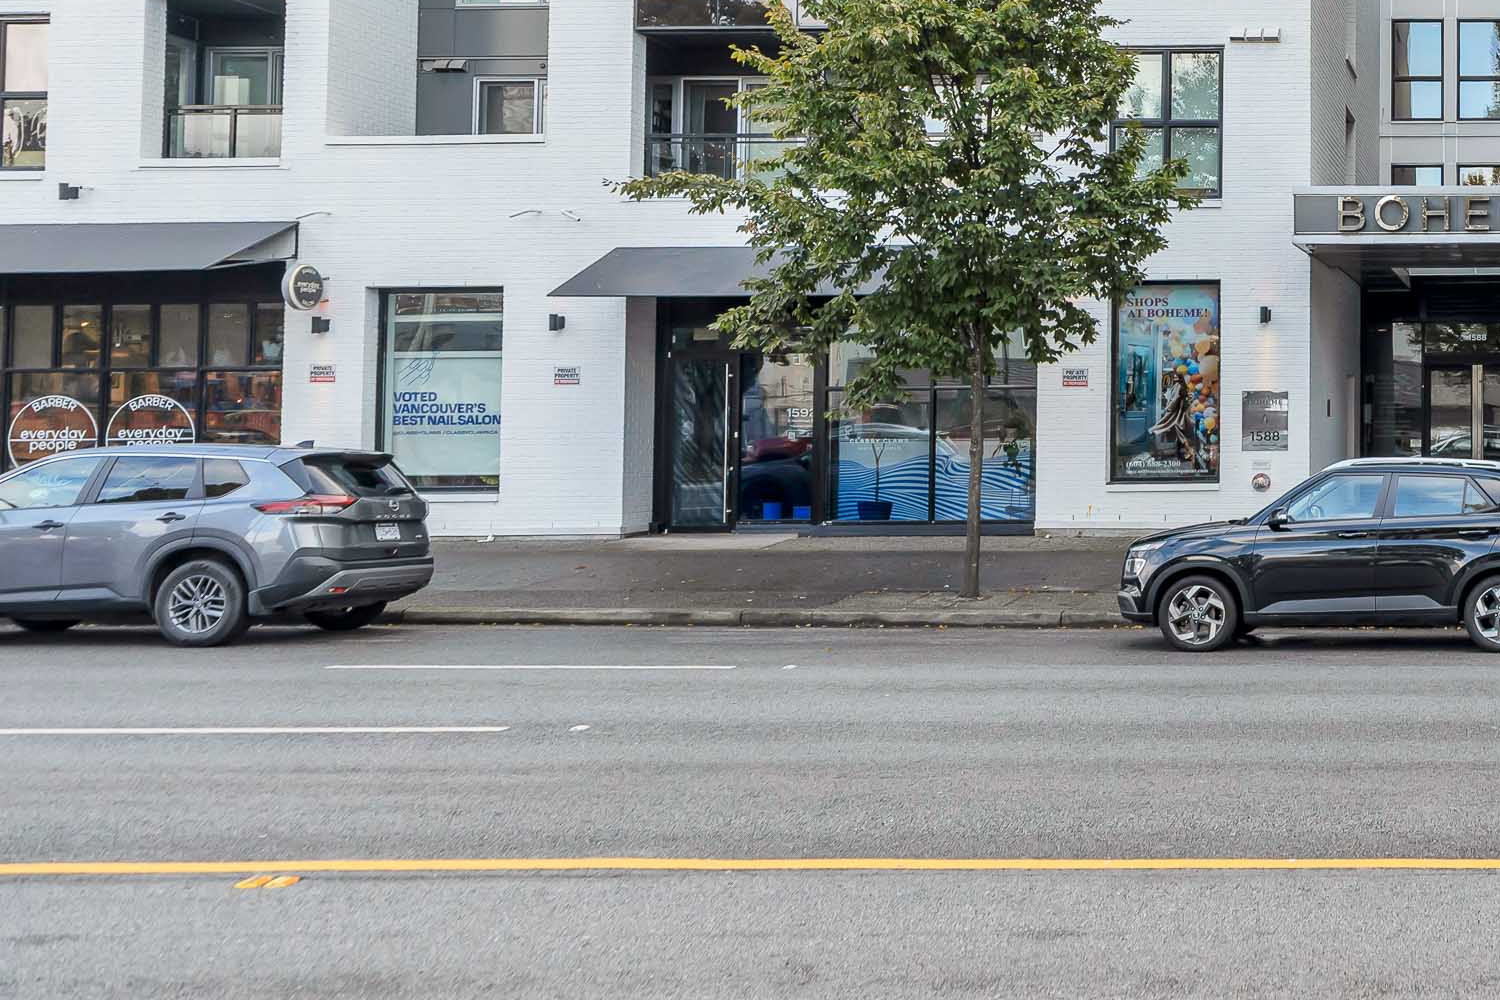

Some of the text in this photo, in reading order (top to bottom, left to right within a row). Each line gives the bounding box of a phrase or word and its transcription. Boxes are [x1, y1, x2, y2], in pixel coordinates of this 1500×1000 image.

[1127, 297, 1169, 307] SHOPS
[1127, 308, 1208, 318] AT BOHEME!
[393, 391, 437, 402] VOTED
[31, 397, 78, 413] BARBER
[128, 397, 175, 412] BARBER
[393, 403, 487, 414] VANCOUVER'S
[392, 414, 501, 425] BEST NAIL SALON
[20, 427, 87, 442] everyday
[117, 426, 184, 441] everyday
[1250, 431, 1280, 441] 1588
[29, 439, 77, 453] people
